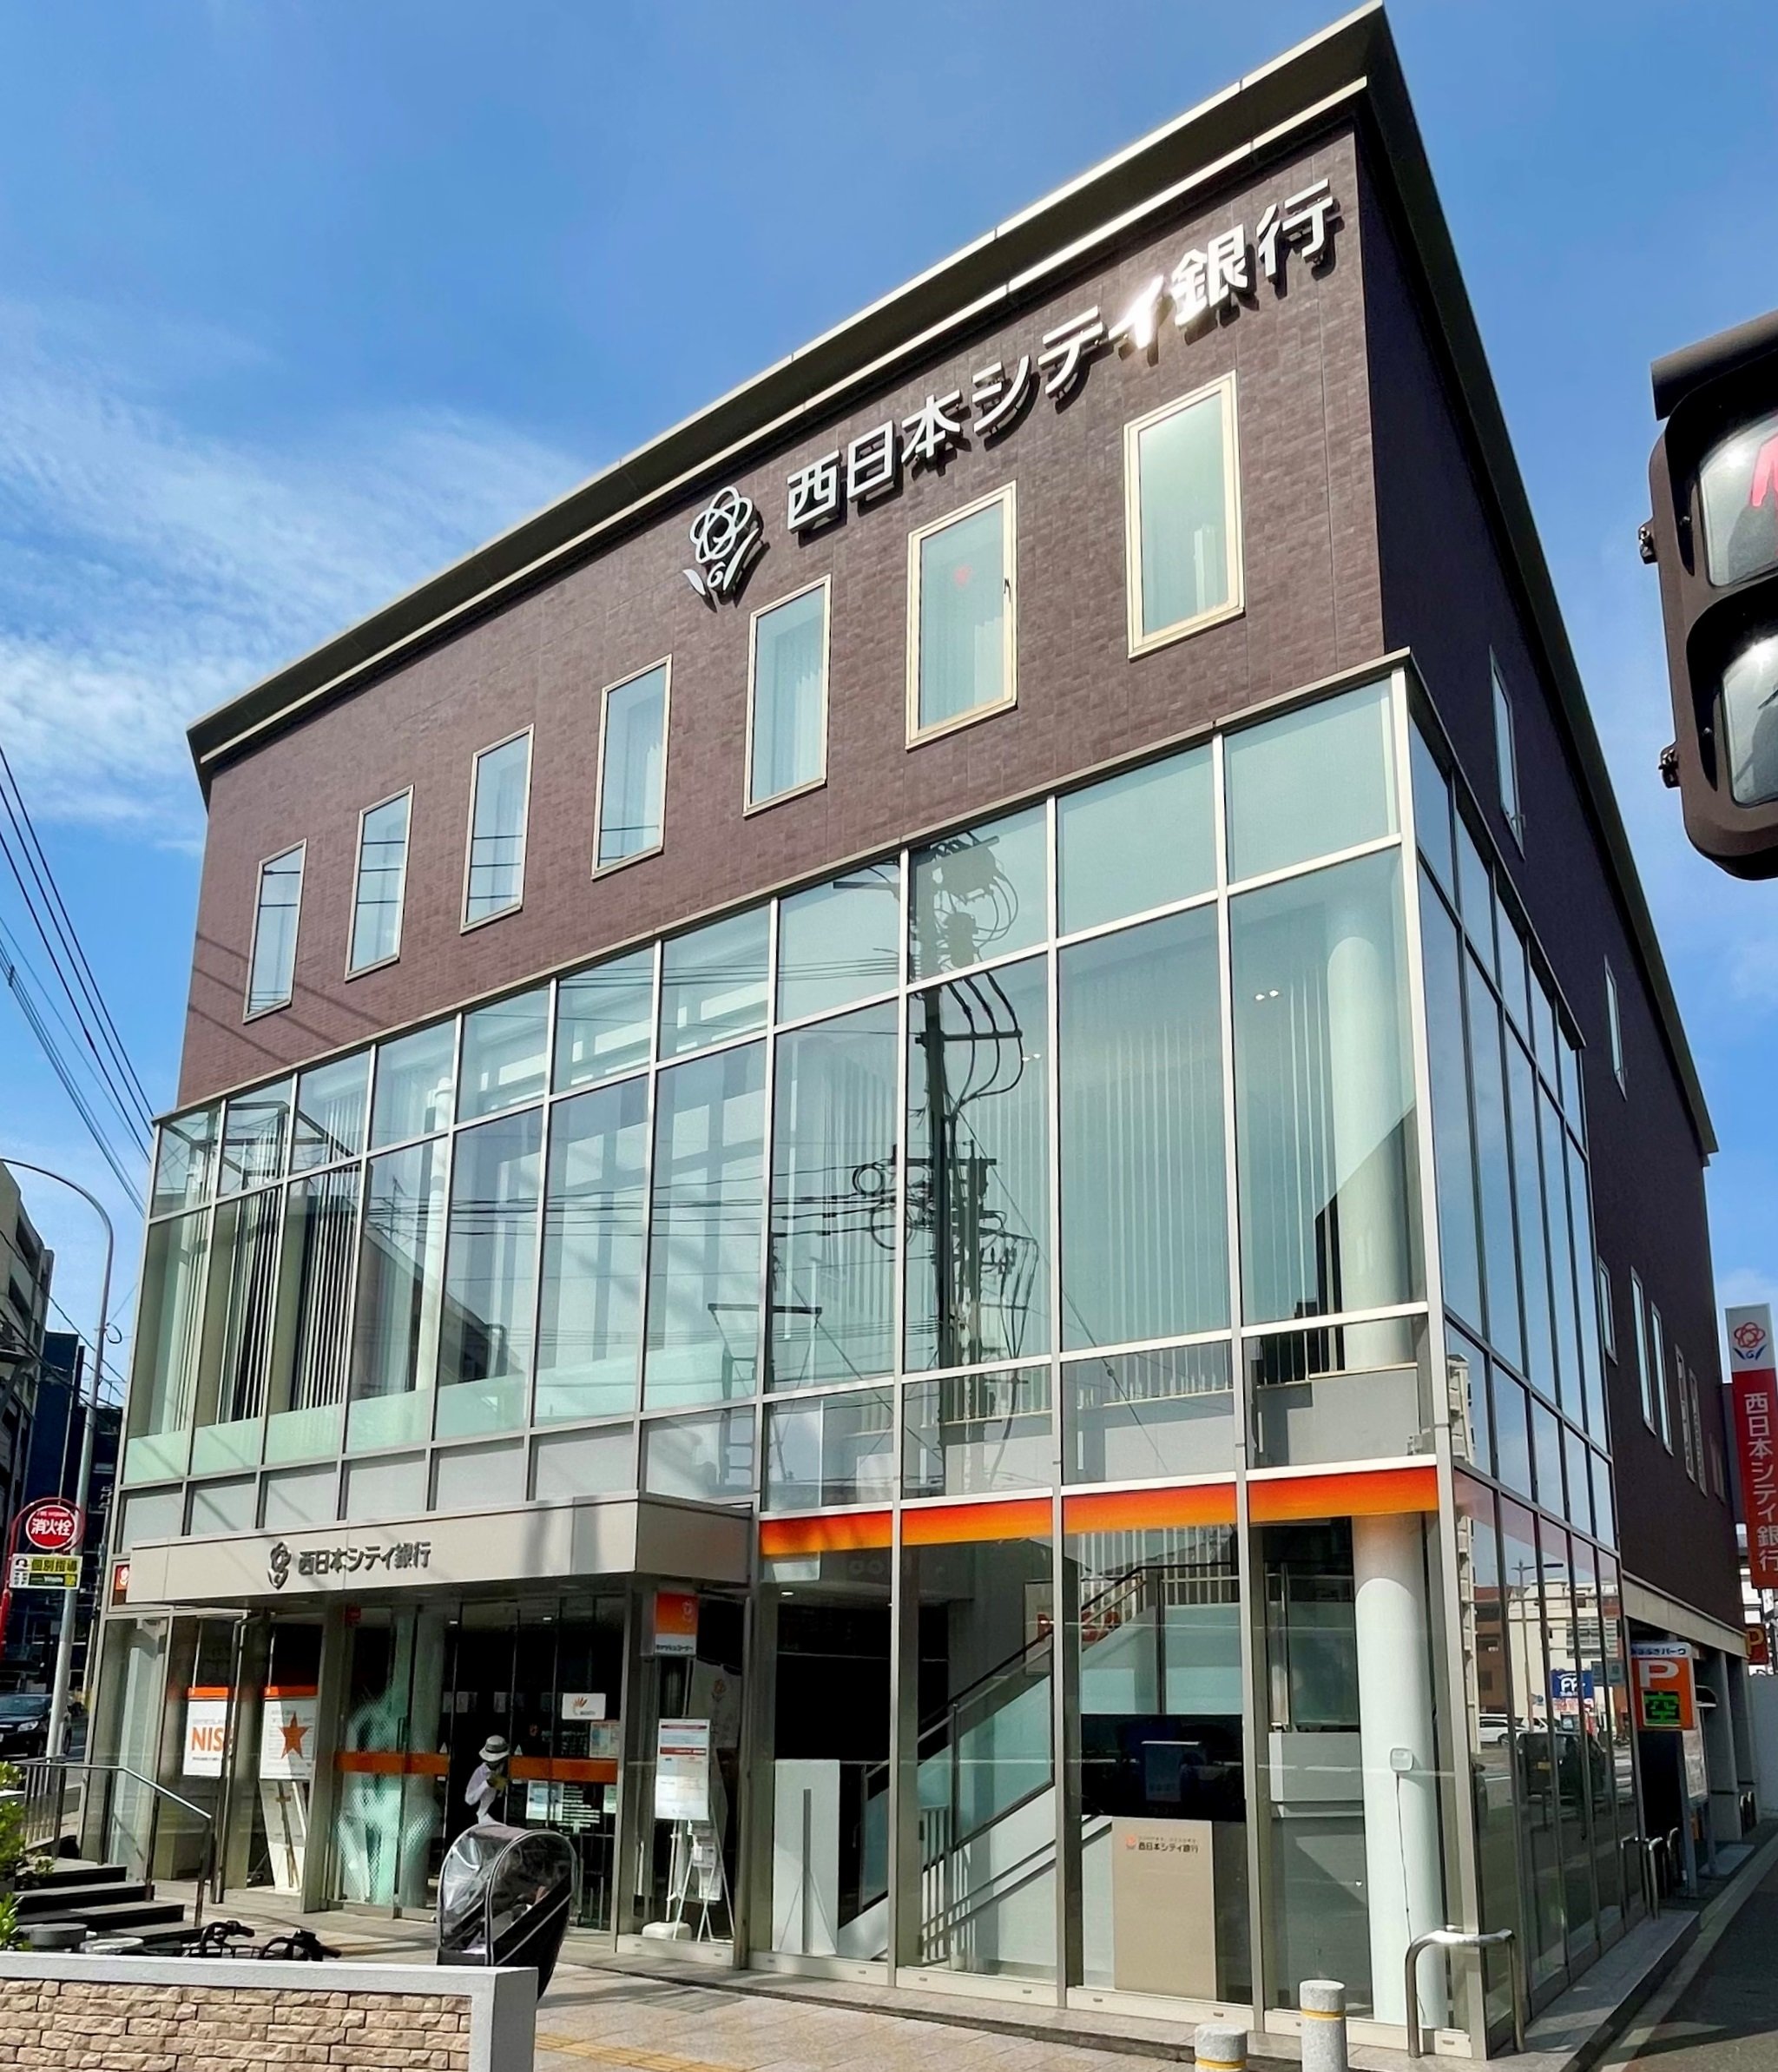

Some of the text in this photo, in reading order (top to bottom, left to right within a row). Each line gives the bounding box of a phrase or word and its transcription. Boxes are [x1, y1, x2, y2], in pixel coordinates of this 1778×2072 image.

[787, 177, 1335, 532] 西日本シティ銀行
[1743, 1392, 1778, 1573] 西日本シティ銀行
[31, 1518, 73, 1536] 消火栓
[298, 1541, 431, 1576] 西日本シティ銀行
[1638, 1660, 1680, 1689] P
[1643, 1692, 1682, 1725] 空
